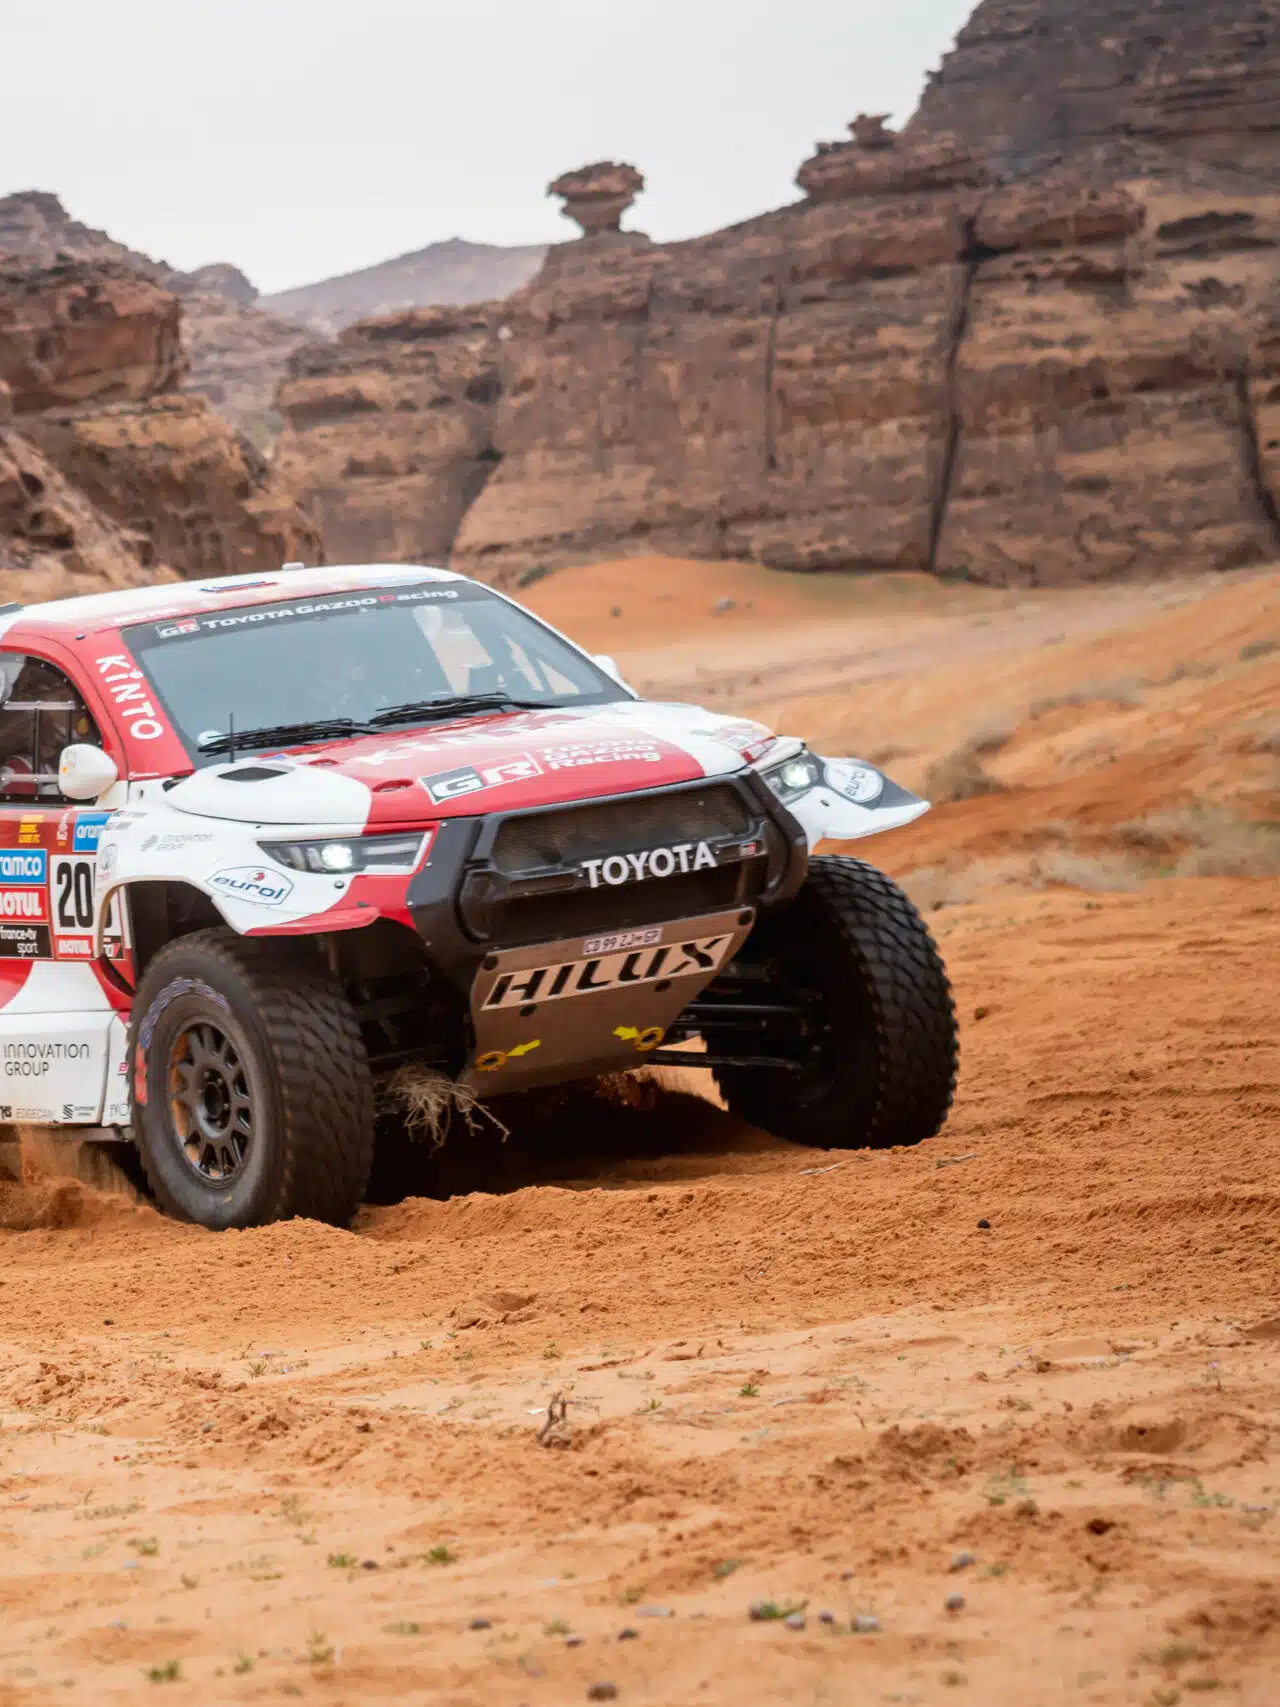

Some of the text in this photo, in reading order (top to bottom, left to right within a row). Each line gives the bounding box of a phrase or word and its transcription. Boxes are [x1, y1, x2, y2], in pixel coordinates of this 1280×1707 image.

[158, 589, 458, 638] GR TOYOTA GAZOO Racing
[548, 752, 661, 770] Racing
[432, 760, 537, 799] GR
[582, 842, 718, 888] TOYOTA
[214, 876, 287, 899] eurol
[17, 942, 39, 957] sport
[487, 937, 725, 1006] HILUX
[4, 1062, 50, 1077] GROUP
